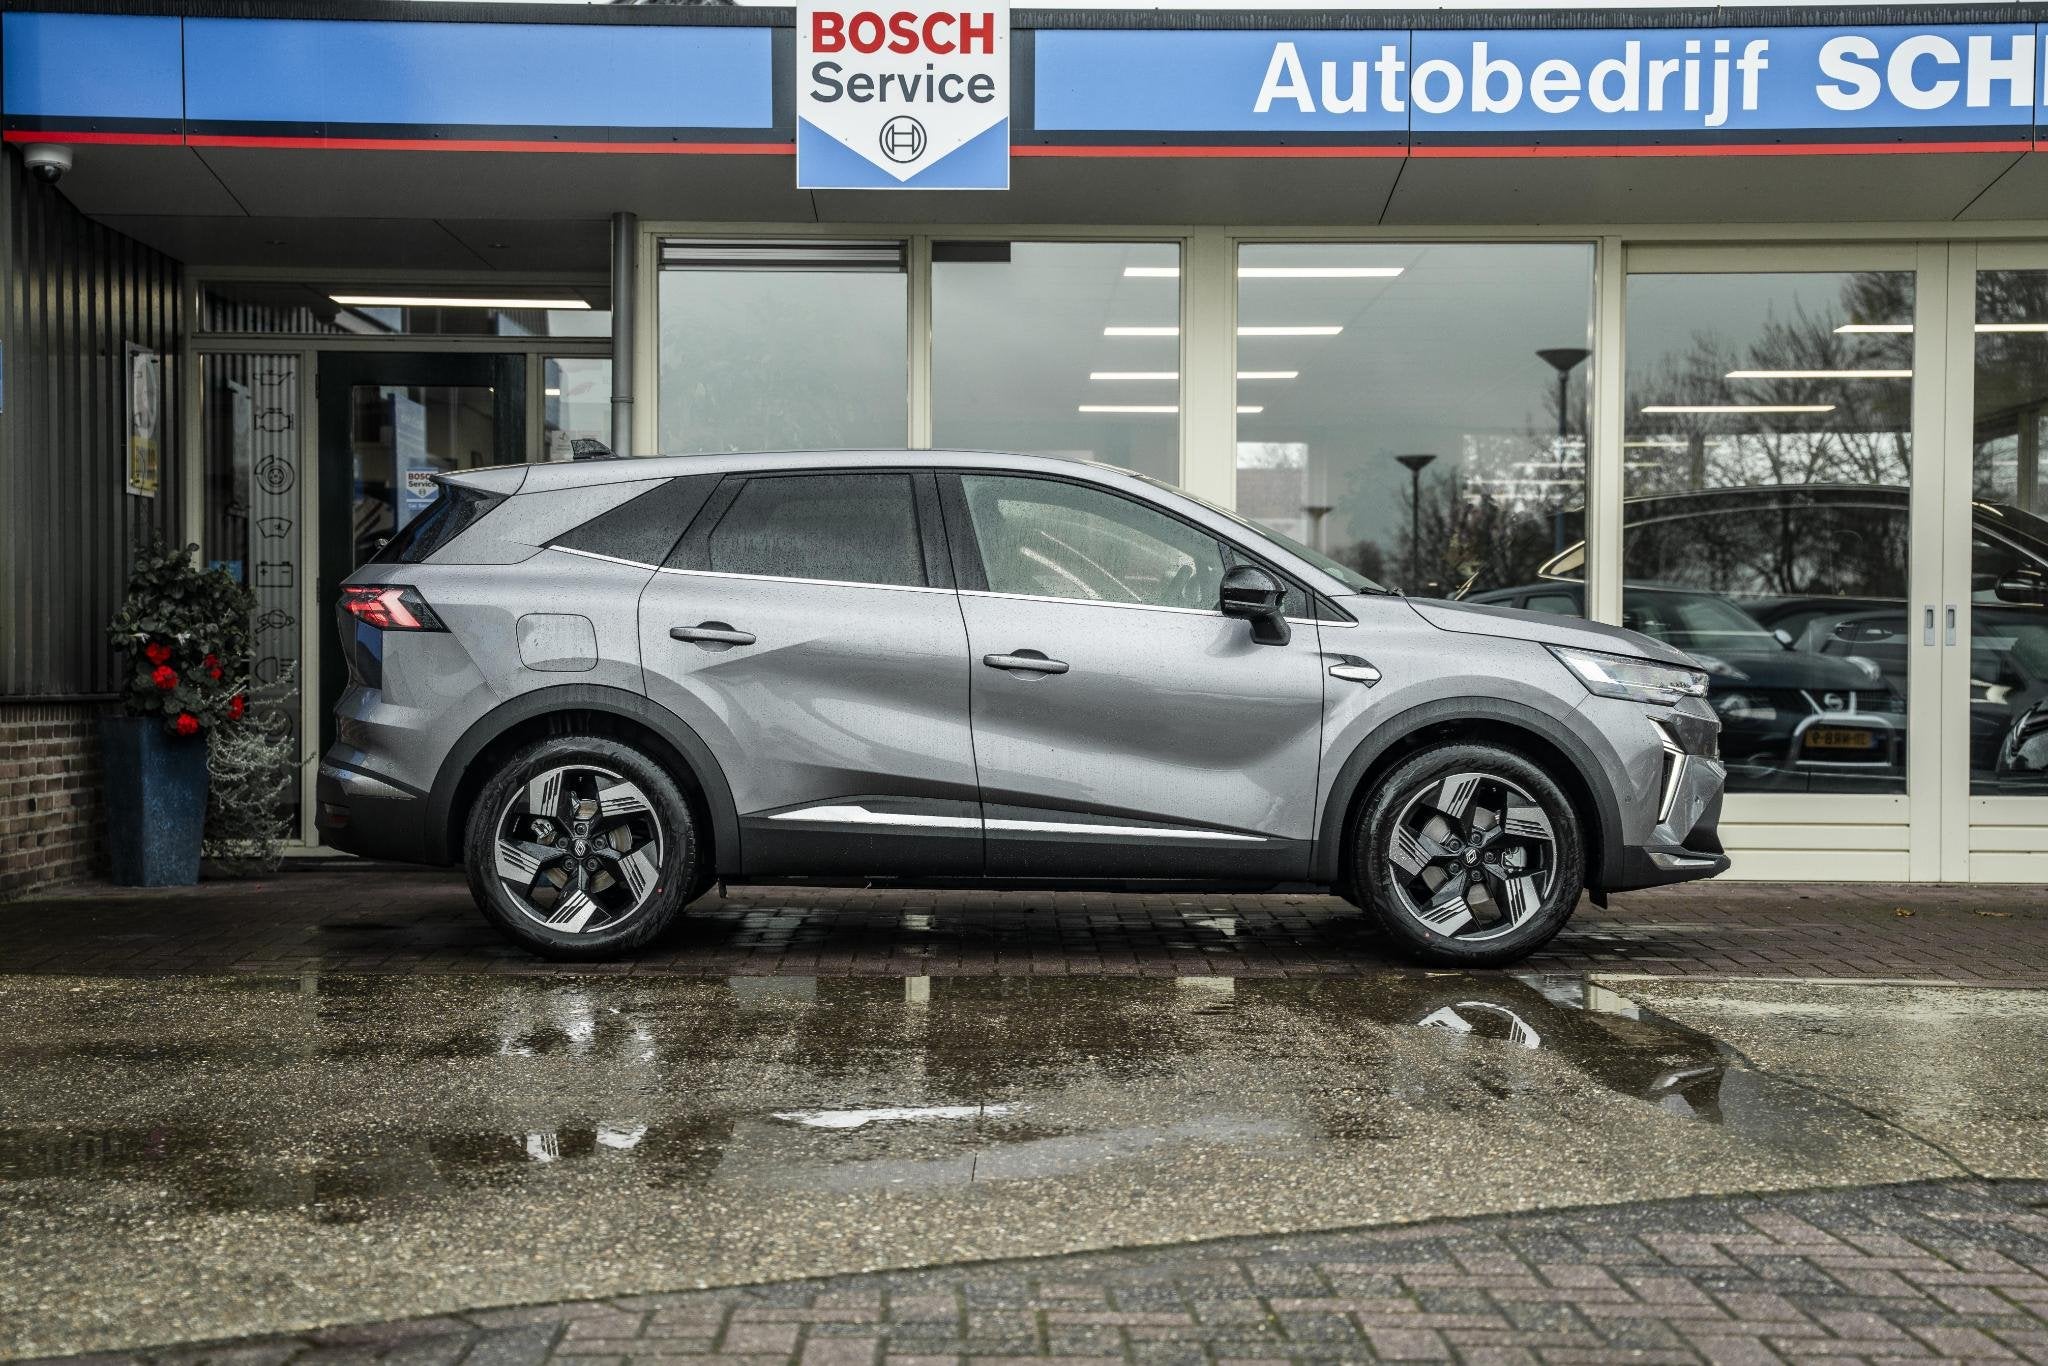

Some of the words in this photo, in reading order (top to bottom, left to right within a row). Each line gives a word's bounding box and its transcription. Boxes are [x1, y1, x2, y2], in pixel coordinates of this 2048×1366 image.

[812, 11, 994, 54] BOSCH
[809, 61, 996, 103] Service
[1253, 39, 1769, 127] Autobedrijf
[1816, 34, 2048, 111] SCH
